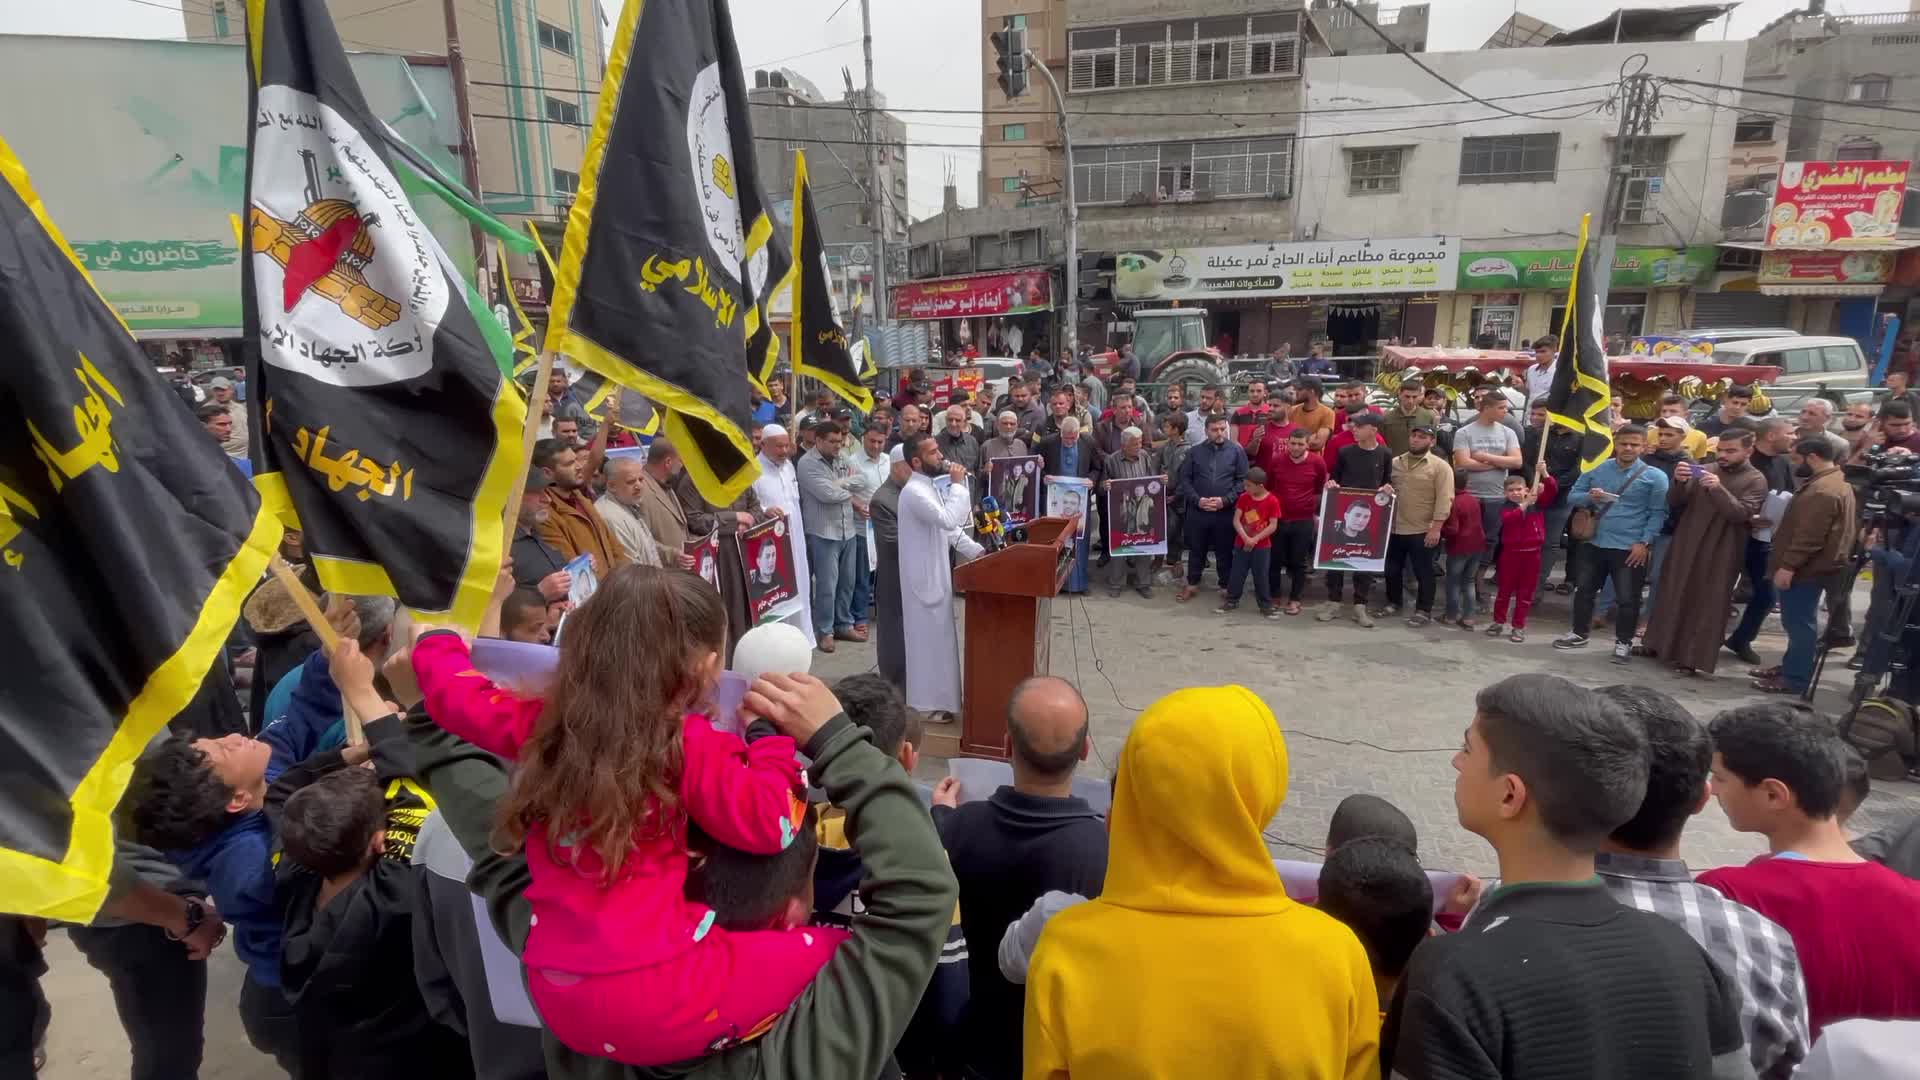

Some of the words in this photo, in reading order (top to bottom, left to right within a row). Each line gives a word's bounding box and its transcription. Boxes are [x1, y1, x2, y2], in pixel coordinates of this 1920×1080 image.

[94, 246, 122, 267] في
[127, 246, 200, 266] حاضرون
[1207, 255, 1243, 272] عكيلة
[1246, 254, 1270, 270] نمر
[1272, 252, 1305, 269] الحاج
[1307, 247, 1334, 267] أبناء
[1336, 250, 1384, 266] مطاعم
[1388, 248, 1447, 264] مجموعة
[373, 324, 423, 359] ركة
[299, 339, 367, 369] الجهاد
[290, 424, 415, 502] الجهاد
